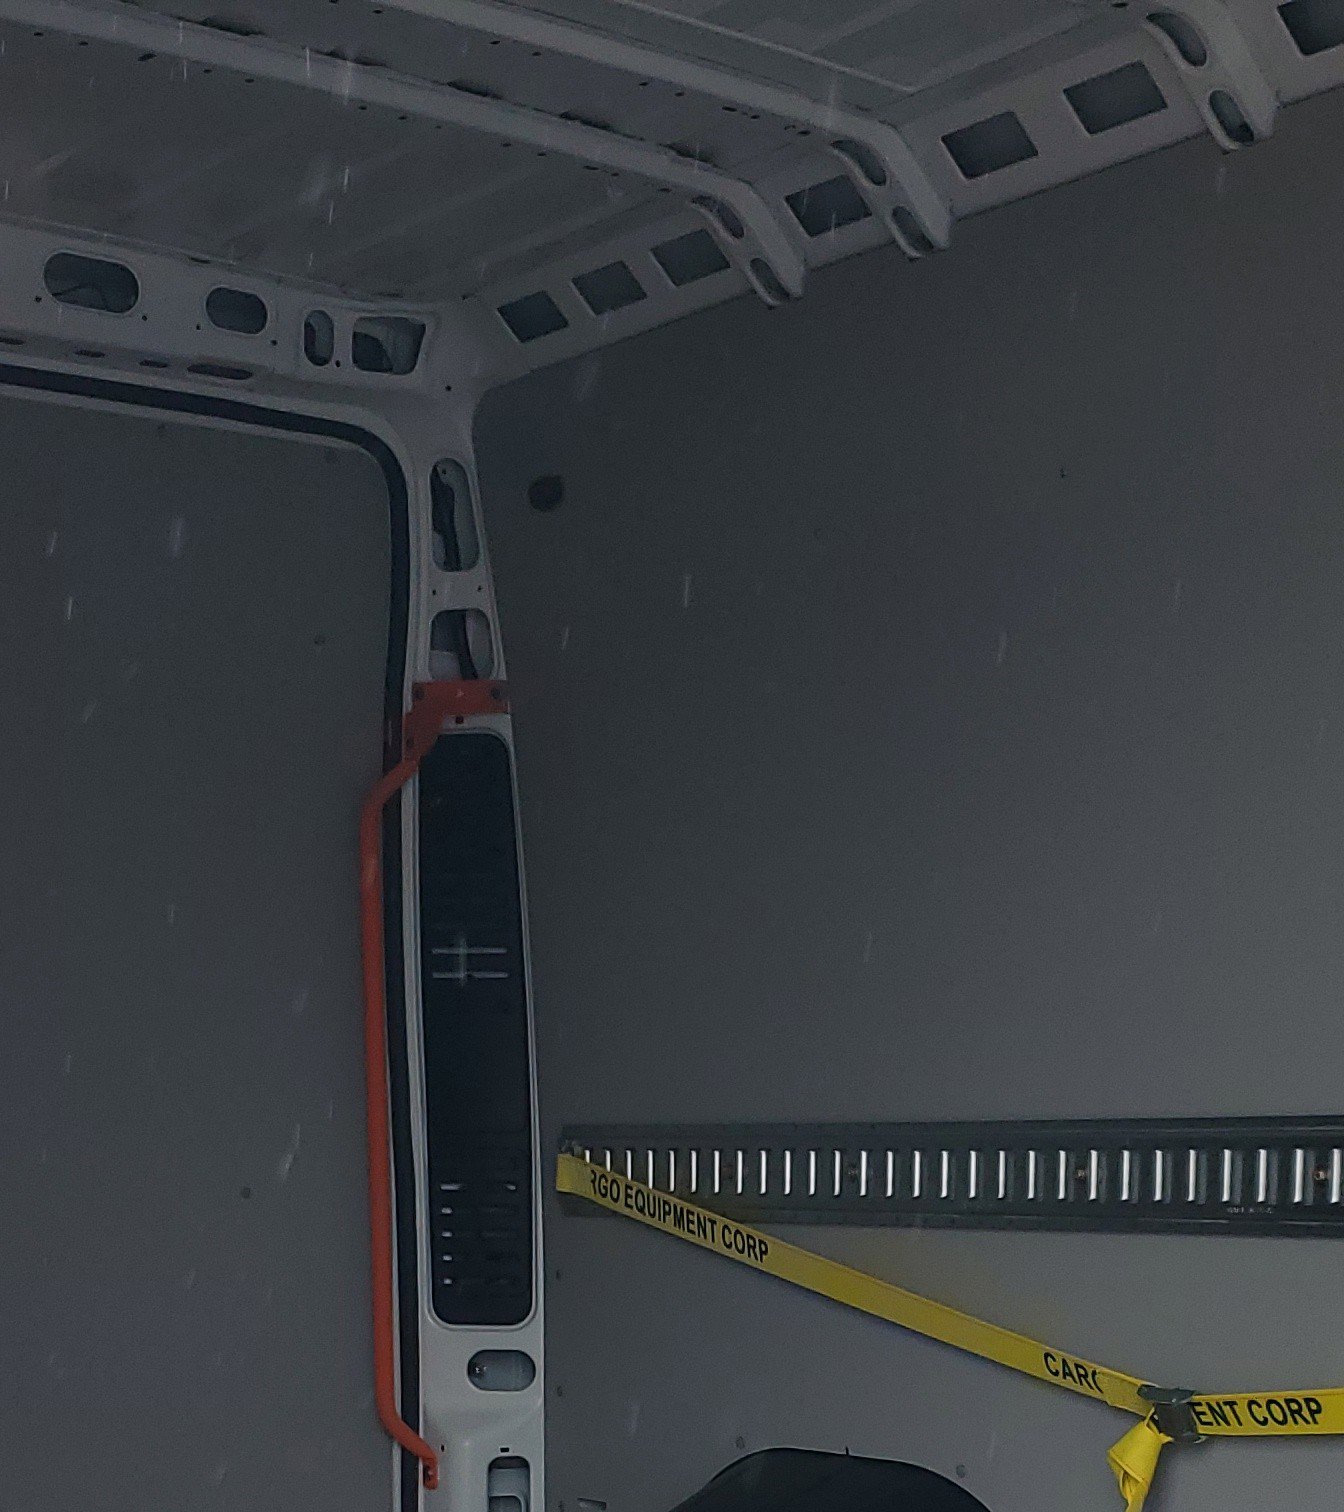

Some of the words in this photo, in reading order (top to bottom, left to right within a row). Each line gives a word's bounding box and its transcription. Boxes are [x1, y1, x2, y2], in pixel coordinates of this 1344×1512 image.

[624, 1183, 718, 1244] EQUIPMENT
[721, 1223, 769, 1264] CORP
[1248, 1397, 1323, 1427] CORP
